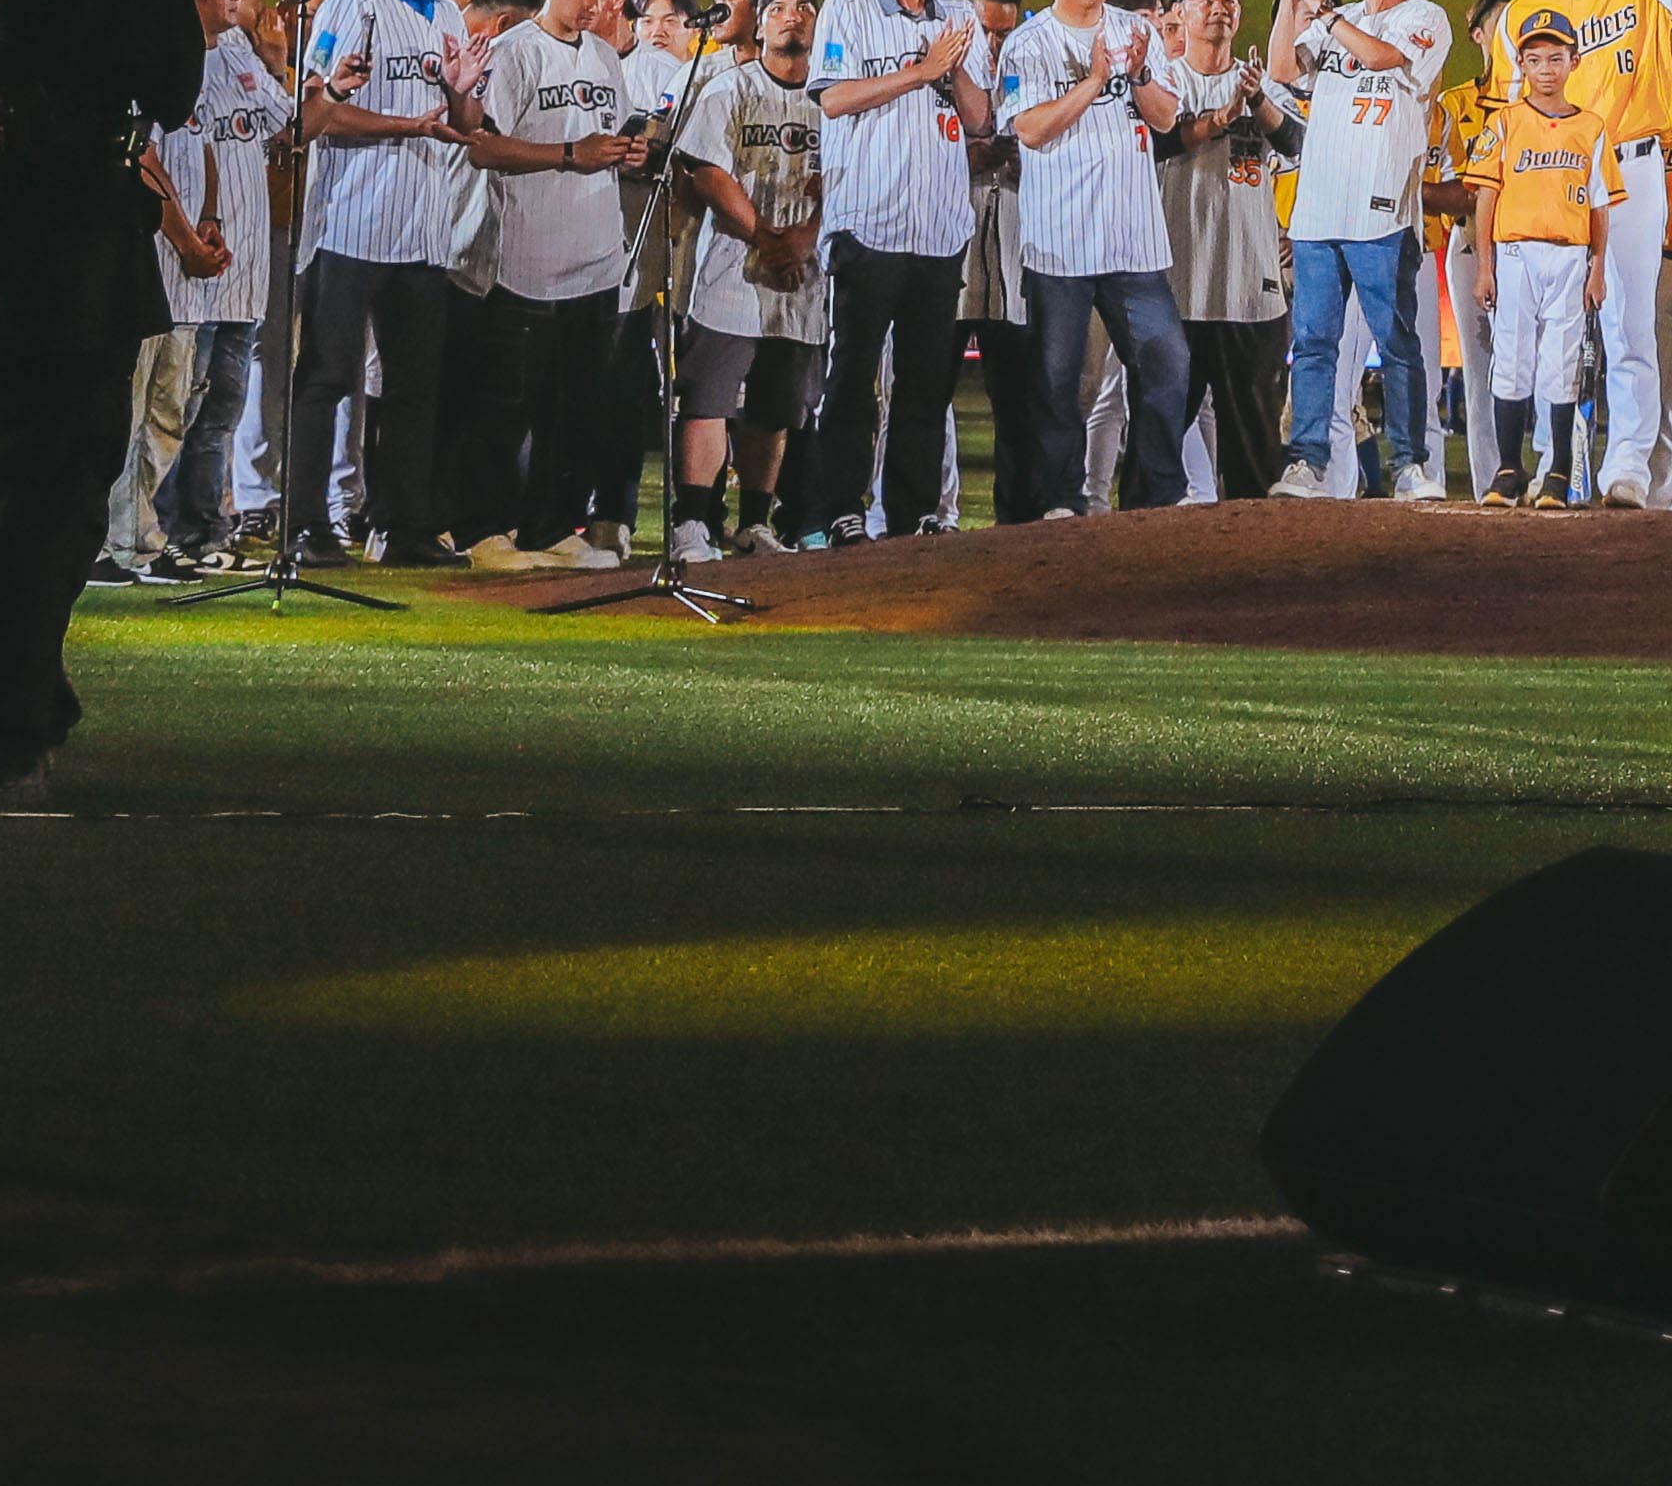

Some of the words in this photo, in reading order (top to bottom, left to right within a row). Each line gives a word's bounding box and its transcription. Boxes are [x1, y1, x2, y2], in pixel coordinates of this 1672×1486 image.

[1579, 3, 1638, 50] thers
[1615, 49, 1634, 75] 16
[1351, 97, 1394, 126] 77
[1228, 159, 1263, 187] 35
[1513, 147, 1590, 173] Brothers
[1567, 183, 1586, 205] 16
